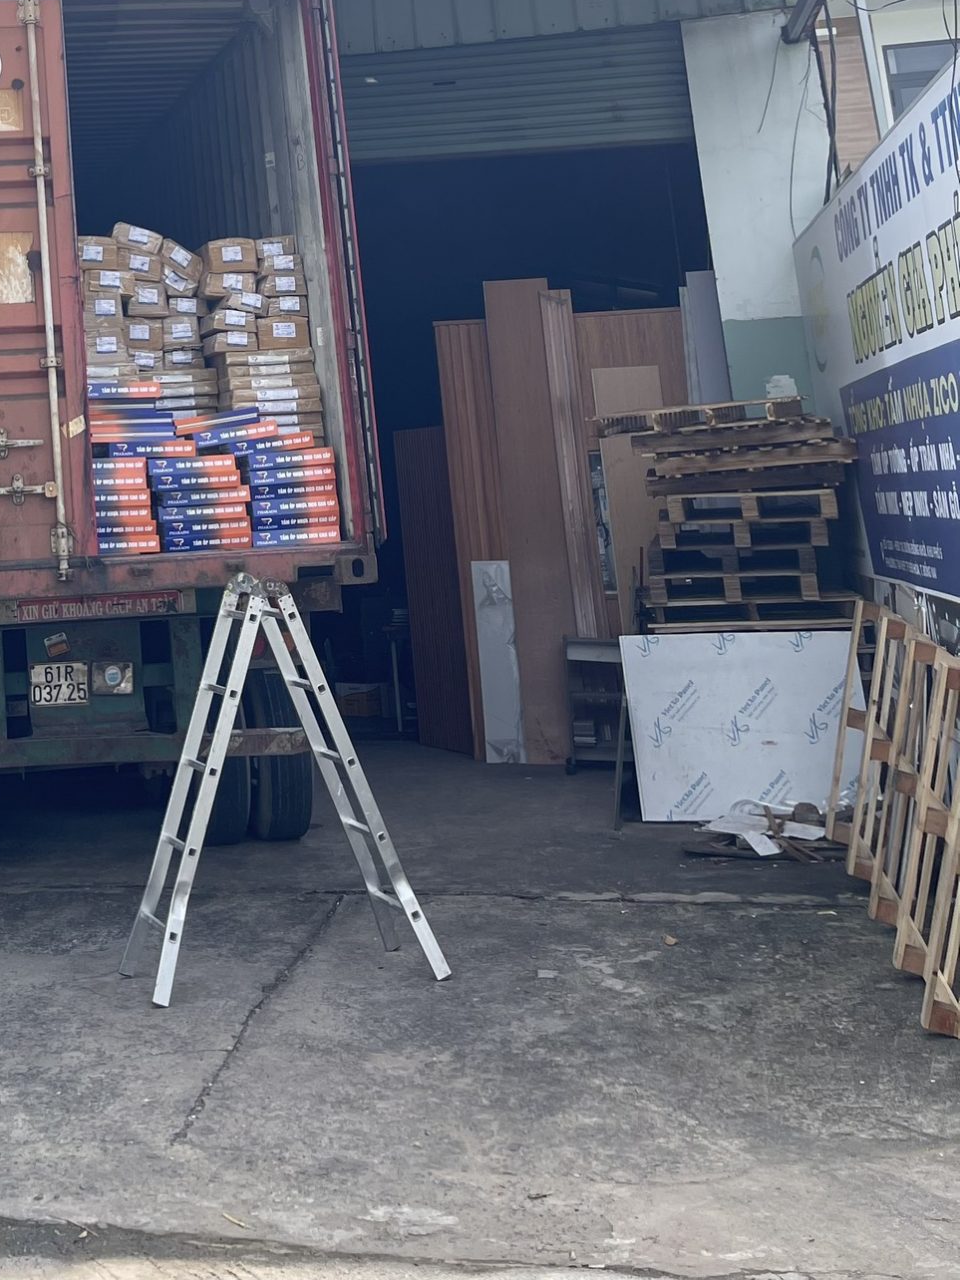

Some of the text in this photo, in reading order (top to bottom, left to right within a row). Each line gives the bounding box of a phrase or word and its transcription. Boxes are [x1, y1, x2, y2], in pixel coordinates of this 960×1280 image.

[857, 180, 872, 241] TY
[869, 151, 902, 230] TNHH
[899, 133, 920, 203] TK
[919, 122, 935, 187] &
[931, 87, 960, 174] TTN
[898, 240, 934, 339] GIA
[930, 372, 958, 416] ZICO
[22, 606, 38, 620] XIN
[136, 599, 148, 612] AN
[44, 665, 74, 684] 61R
[33, 682, 87, 703] 037.25
